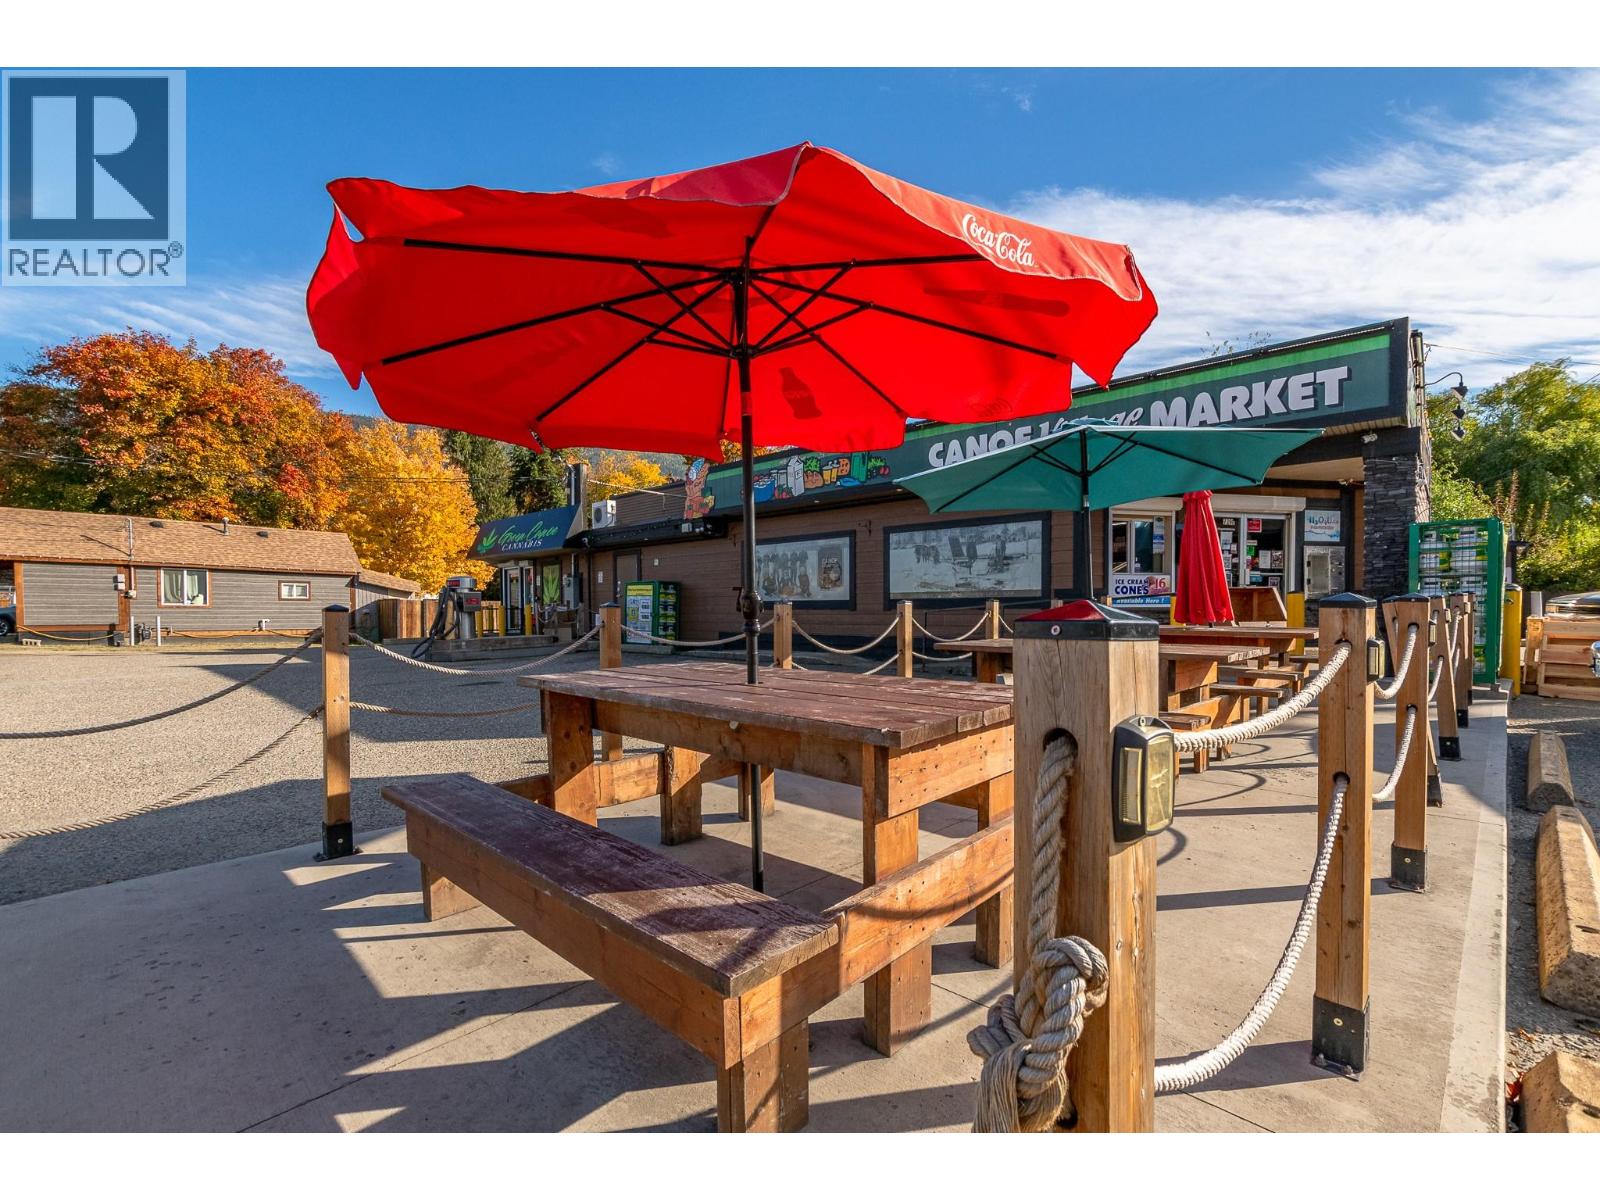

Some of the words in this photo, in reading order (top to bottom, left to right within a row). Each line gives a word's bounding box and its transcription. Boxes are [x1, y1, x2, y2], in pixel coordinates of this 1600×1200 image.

[962, 213, 1035, 267] Coca-Cola
[1150, 366, 1348, 427] MARKET
[502, 539, 543, 551] CANNABIS
[1115, 585, 1149, 594] CONES
